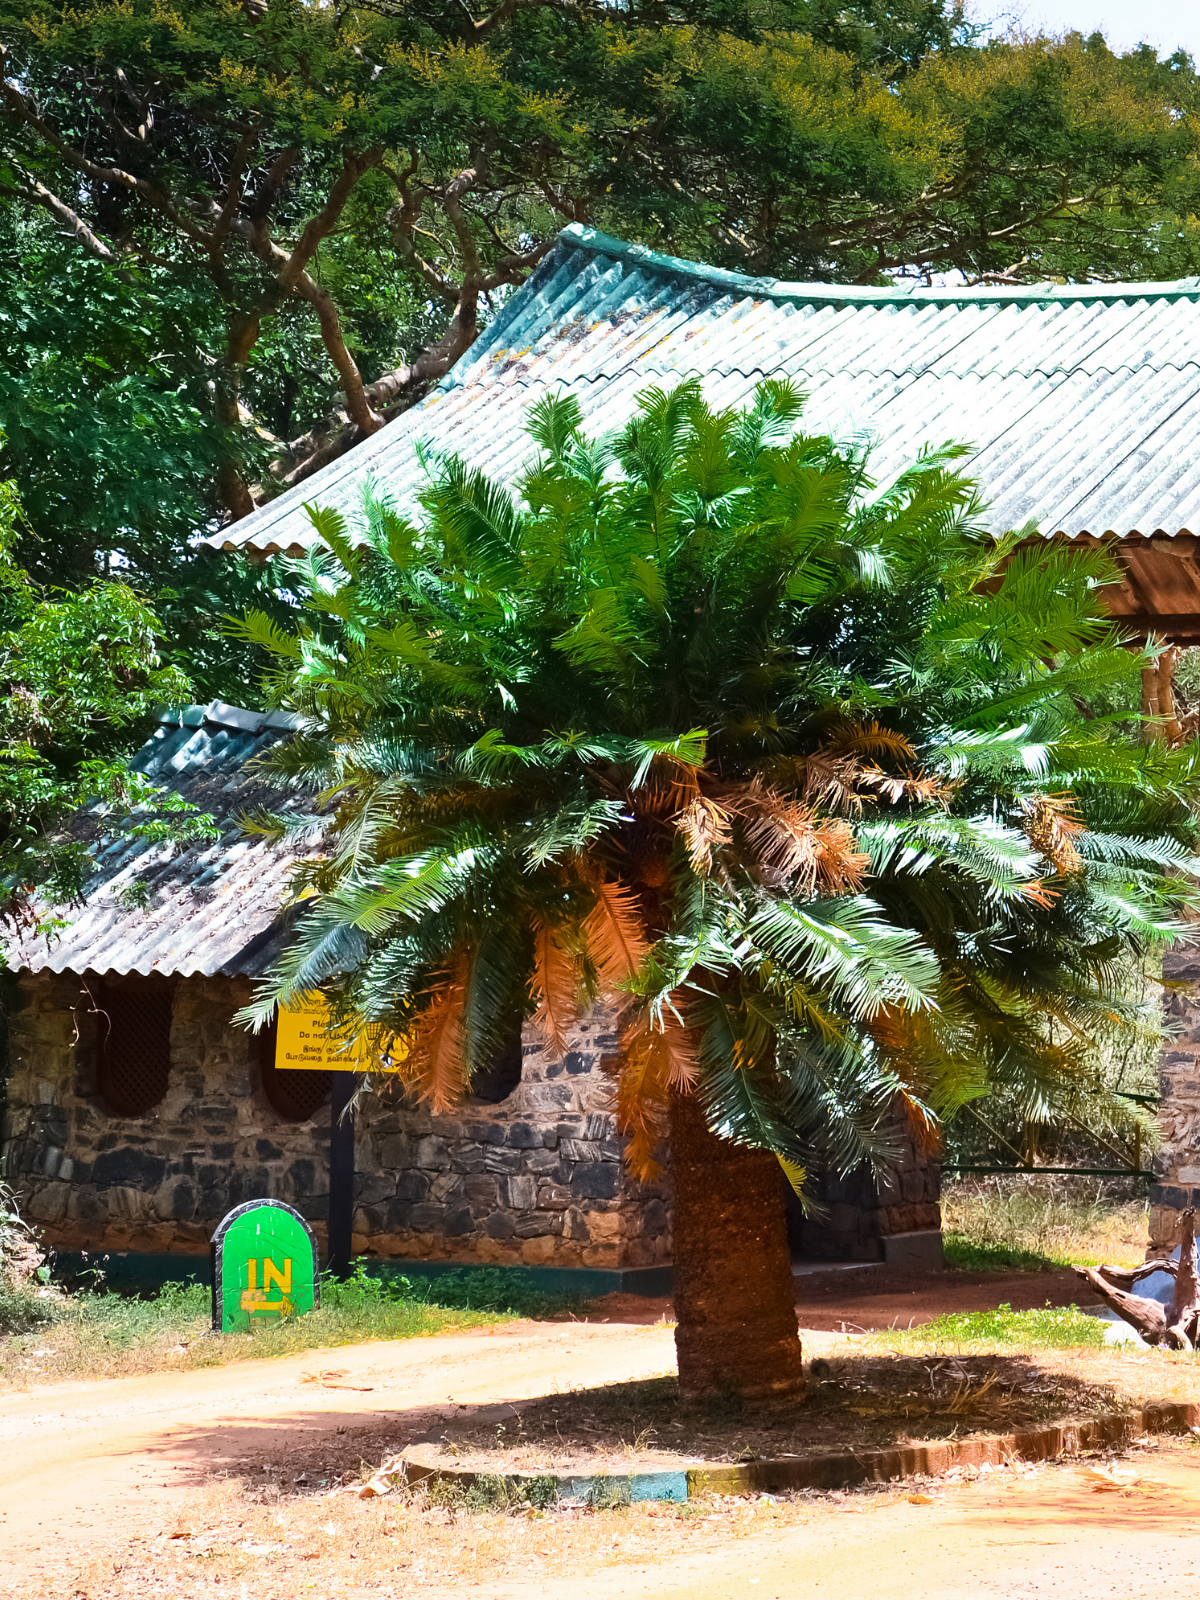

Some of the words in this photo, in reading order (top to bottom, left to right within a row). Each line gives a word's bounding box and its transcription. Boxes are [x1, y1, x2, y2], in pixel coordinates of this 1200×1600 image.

[299, 1031, 310, 1039] Do
[312, 1032, 326, 1040] not
[248, 1257, 292, 1294] IN
